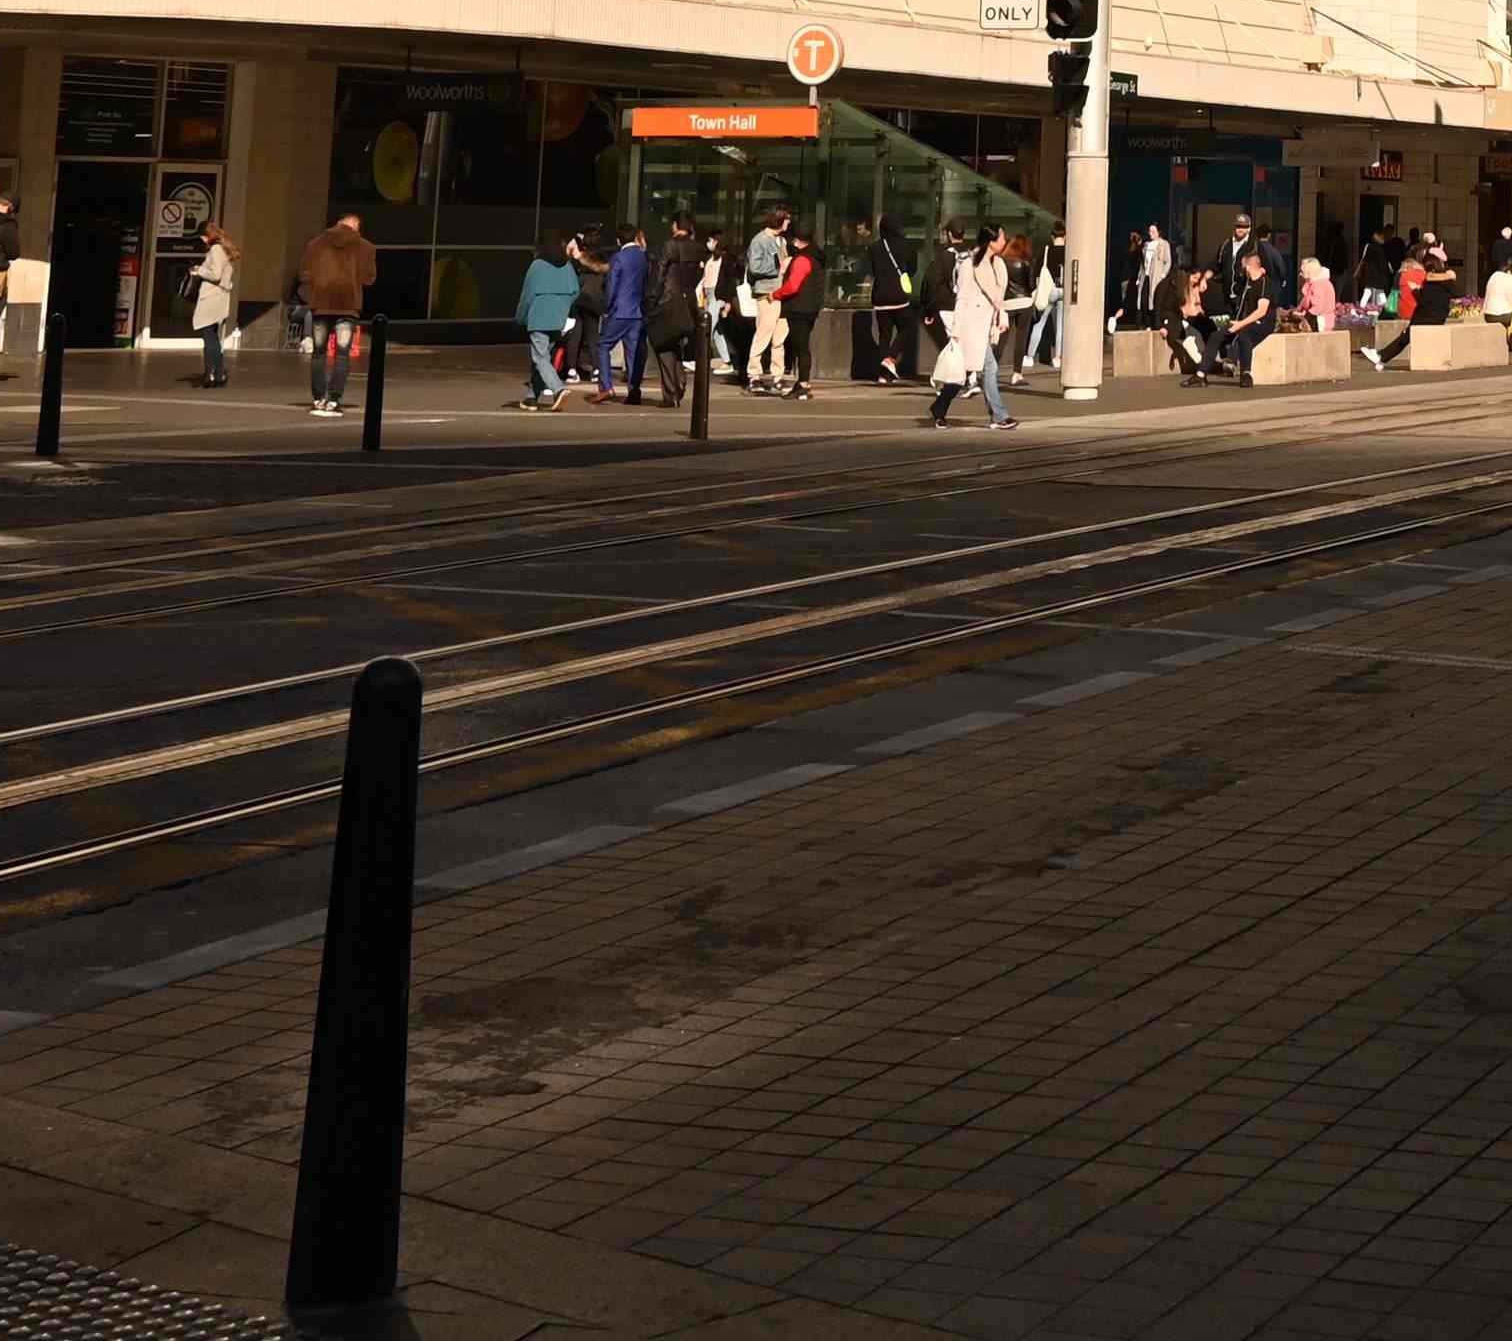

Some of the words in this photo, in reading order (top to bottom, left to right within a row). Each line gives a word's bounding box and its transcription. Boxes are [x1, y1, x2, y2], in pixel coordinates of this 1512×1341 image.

[985, 6, 1033, 21] ONLY
[803, 39, 825, 71] T
[405, 83, 486, 101] woolworths
[688, 114, 727, 131] Town
[729, 114, 757, 131] Hall
